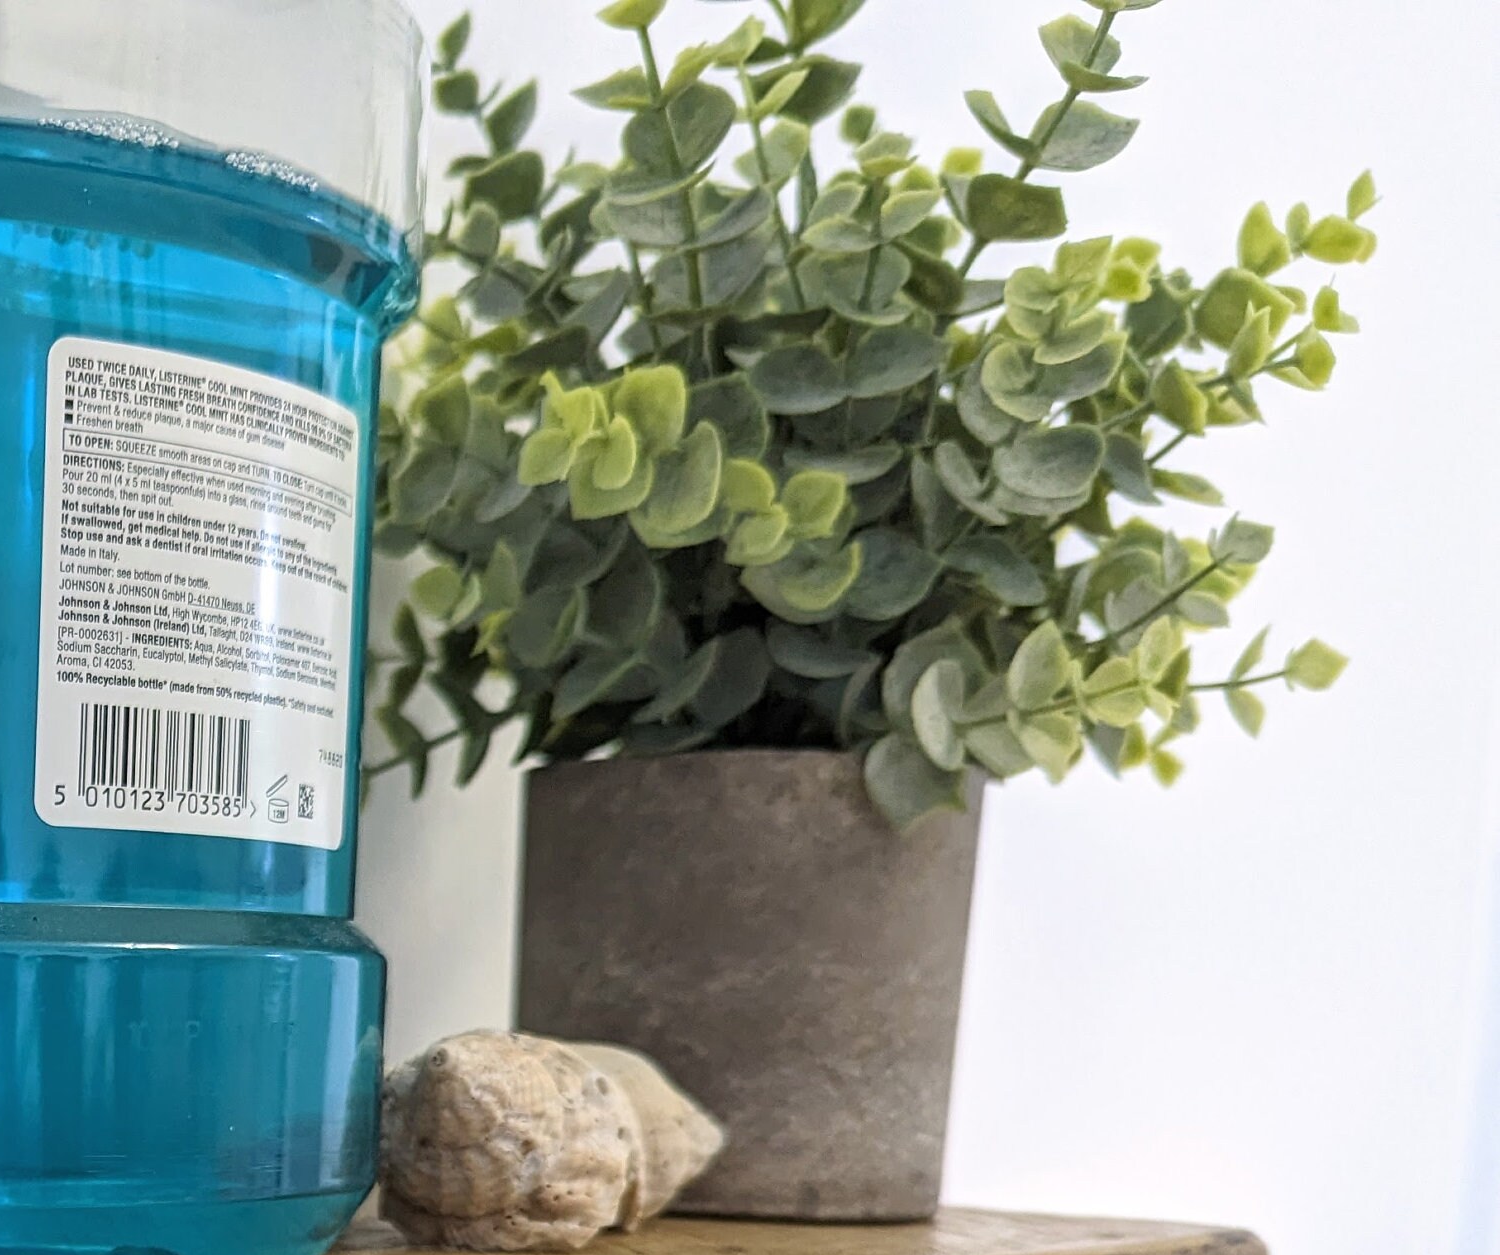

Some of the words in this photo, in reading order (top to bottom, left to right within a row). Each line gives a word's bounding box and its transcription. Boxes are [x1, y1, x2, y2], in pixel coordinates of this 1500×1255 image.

[65, 371, 107, 387] PLAQUE,
[110, 377, 136, 391] GIVES
[139, 380, 176, 397] LASTING
[68, 356, 94, 371] USED
[97, 361, 127, 376] TWICE
[129, 365, 157, 383] DAILY,
[208, 379, 229, 396] COOL
[65, 385, 75, 396] IN
[77, 387, 97, 399] LAB
[101, 389, 132, 404] TESTS.
[77, 400, 111, 415] Prevent
[76, 414, 112, 429] Freshen
[114, 418, 143, 434] breath
[69, 435, 82, 447] TO
[84, 437, 113, 451] OPEN:
[116, 439, 156, 457] SQUEEZE
[63, 454, 124, 471] DIRECTIONS:
[128, 462, 169, 480] Especially
[63, 483, 74, 494] 30
[77, 485, 117, 501] seconds,
[61, 500, 79, 512] Not
[82, 502, 120, 517] suitable
[71, 515, 126, 532] swallowed,
[61, 527, 83, 542] Stop
[60, 544, 86, 557] Made
[99, 548, 120, 562] Italy.
[60, 561, 75, 573] Lot
[77, 563, 114, 578] number:
[59, 579, 105, 595] JOHNSON
[108, 583, 114, 594] &
[117, 583, 160, 599] JOHNSON
[162, 588, 185, 603] GmbH
[59, 595, 100, 609] Johnson
[57, 671, 83, 684] 100%
[86, 672, 135, 689] Recyclable
[53, 784, 65, 806] 5
[85, 786, 165, 812] 010123
[177, 793, 242, 818] 703585
